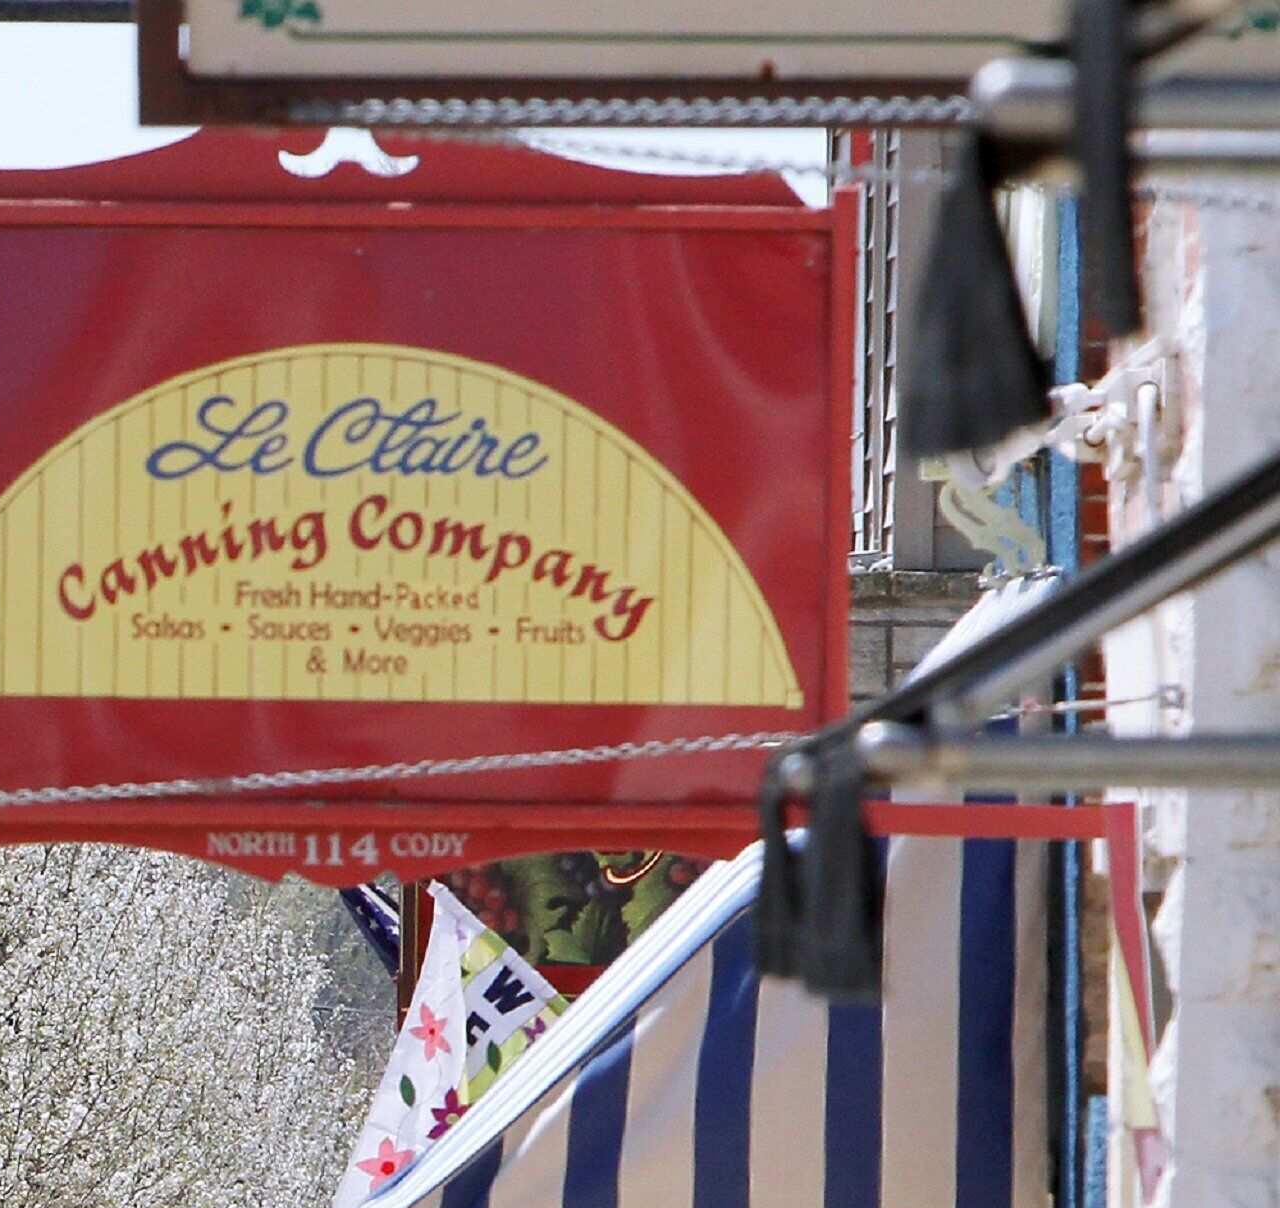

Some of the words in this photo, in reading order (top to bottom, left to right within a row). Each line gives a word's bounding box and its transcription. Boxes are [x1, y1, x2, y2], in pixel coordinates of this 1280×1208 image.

[145, 396, 295, 480] Le
[302, 397, 550, 479] Claire
[58, 500, 328, 621] Canning
[348, 494, 655, 641] Company
[234, 581, 301, 607] Fresh
[309, 581, 480, 610] Hand-Packed
[131, 612, 206, 640] Salsas
[247, 613, 332, 641] Sauces
[373, 615, 473, 647] Veggies
[516, 616, 587, 645] Fruits
[306, 645, 327, 674] &
[342, 648, 409, 675] More
[206, 831, 296, 856] NORTH
[302, 832, 380, 866] 114
[390, 832, 470, 858] CODY
